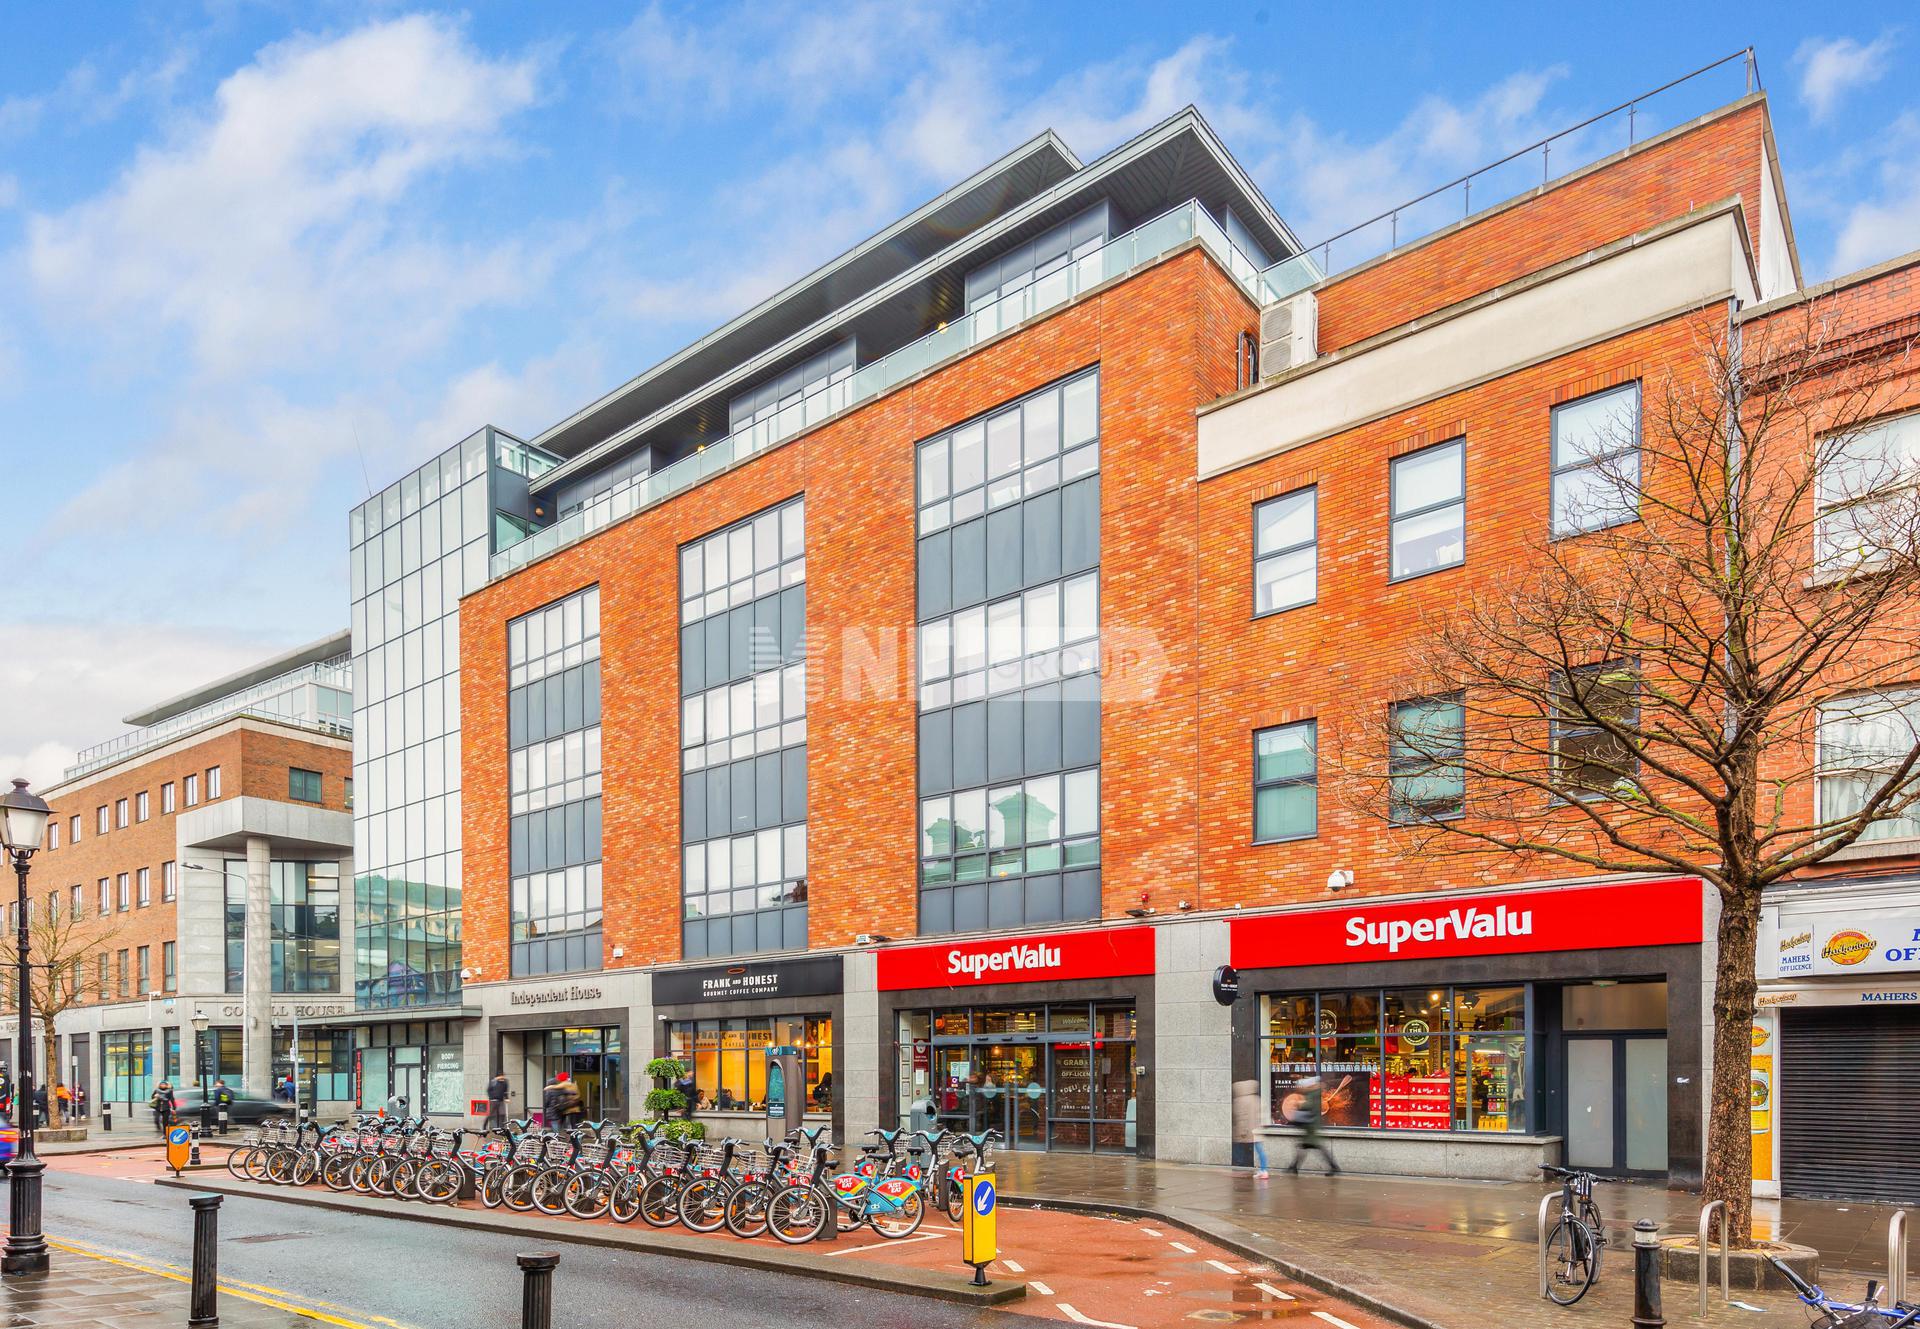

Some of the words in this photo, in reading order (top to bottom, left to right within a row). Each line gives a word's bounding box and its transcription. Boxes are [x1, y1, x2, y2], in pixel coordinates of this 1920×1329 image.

[1345, 905, 1532, 953] SuperValu
[1821, 939, 1877, 959] Hackenberg
[1885, 948, 1920, 961] OF
[948, 943, 1061, 979] SuperValu
[1782, 955, 1811, 964] MAHERS
[703, 978, 730, 989] FRANK
[743, 974, 778, 986] HONEST
[511, 989, 568, 1007] Independent
[571, 986, 602, 1001] House
[1861, 992, 1918, 1001] MAHERS
[295, 1005, 345, 1016] HOUSE
[1063, 1059, 1084, 1067] GRAB
